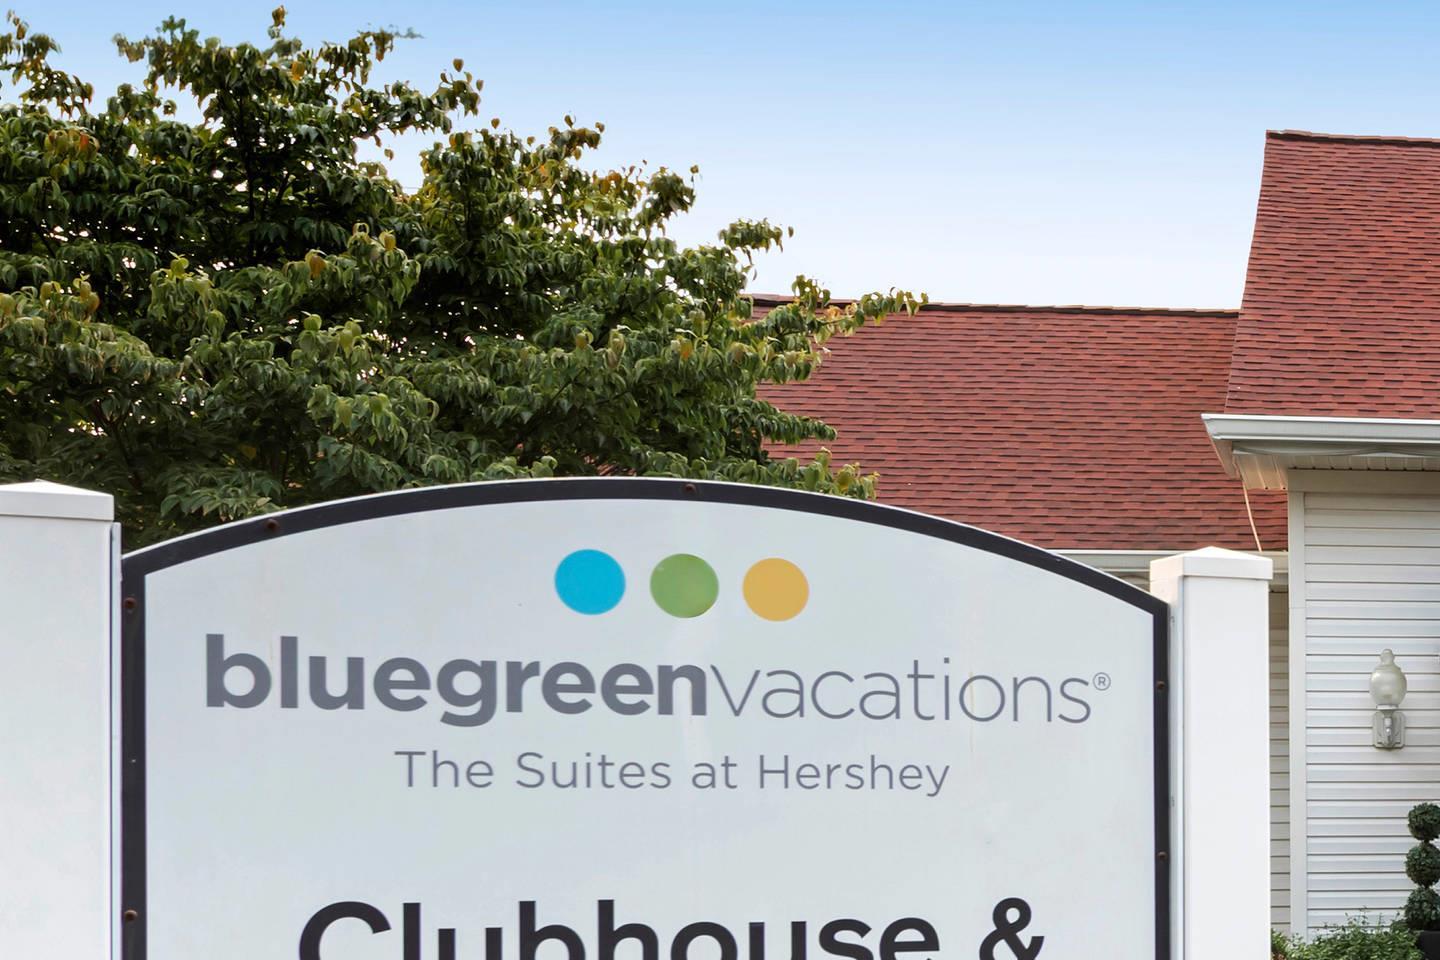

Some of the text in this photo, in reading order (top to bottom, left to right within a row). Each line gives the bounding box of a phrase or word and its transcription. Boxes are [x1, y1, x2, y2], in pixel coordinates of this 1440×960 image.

[394, 749, 950, 798] The Suites at Hershey
